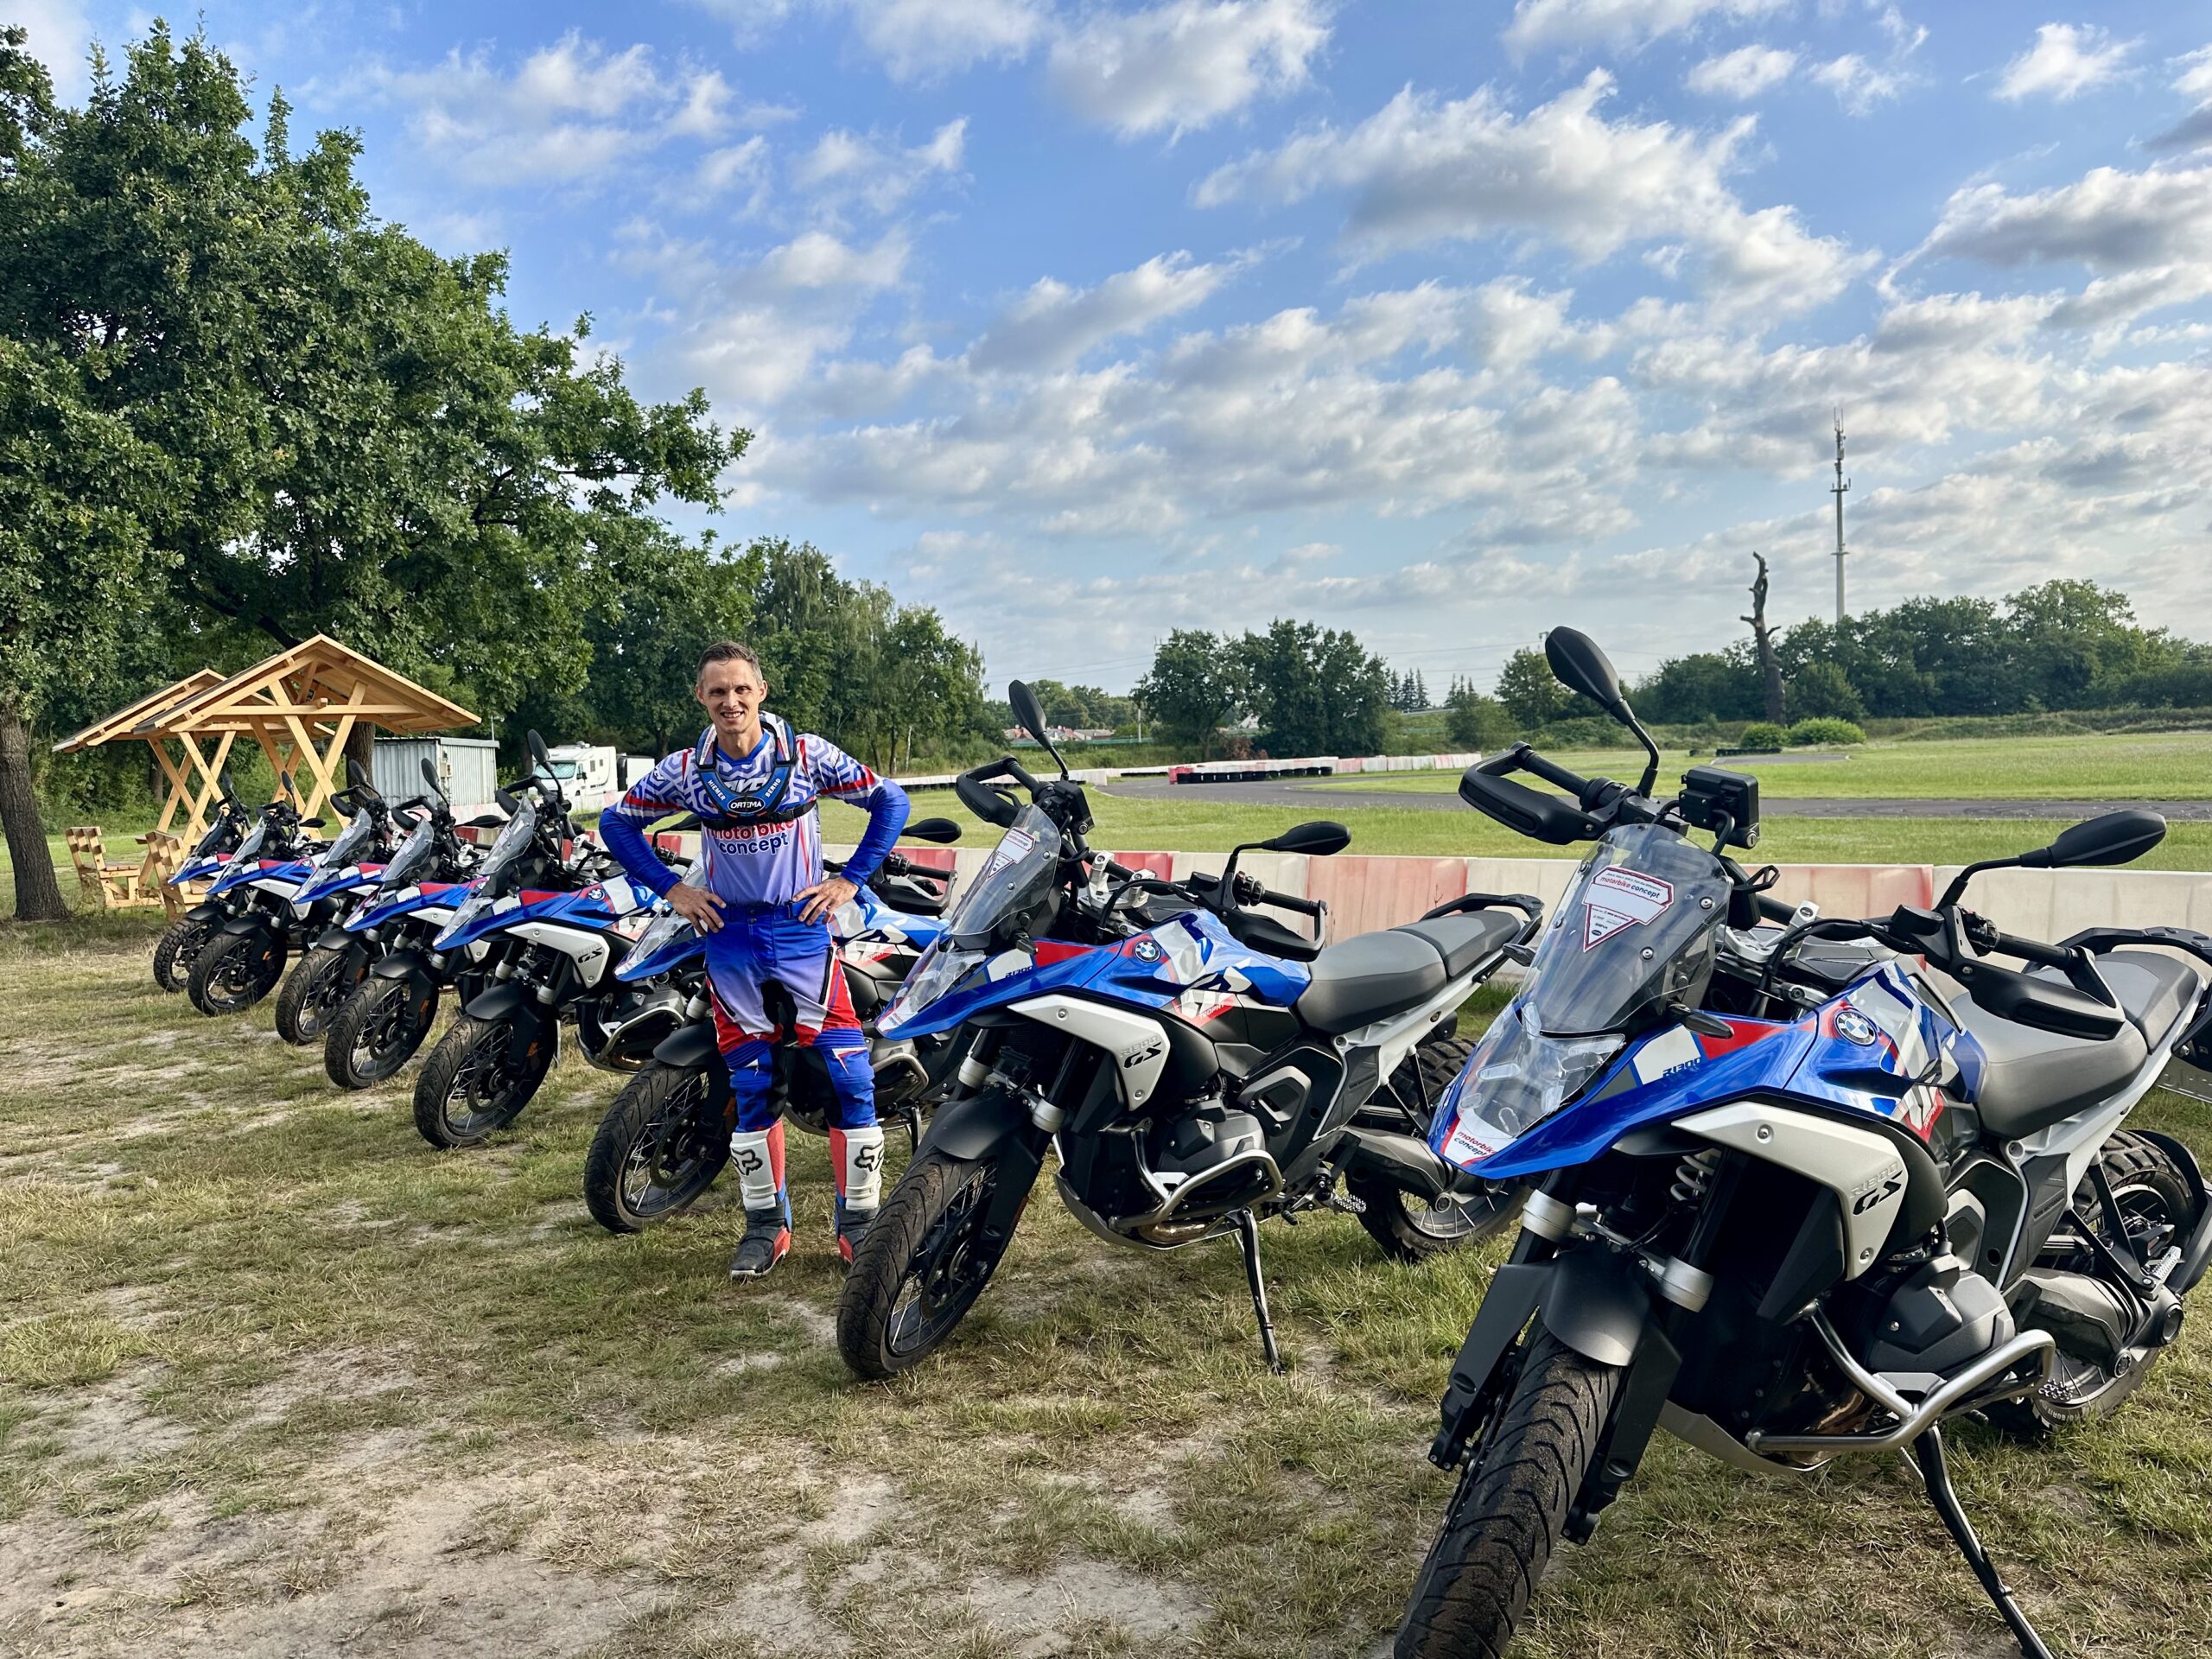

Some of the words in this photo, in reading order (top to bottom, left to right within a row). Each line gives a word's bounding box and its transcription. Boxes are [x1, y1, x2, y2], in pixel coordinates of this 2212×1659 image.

[707, 779, 726, 801] HIEMER
[765, 779, 781, 798] BERND
[719, 832, 789, 855] concept
[1600, 876, 1631, 887] motorbike
[1631, 885, 1660, 898] concept
[578, 946, 602, 963] GS
[1123, 1042, 1161, 1069] GS
[1454, 1137, 1487, 1155] concept
[1853, 1170, 1903, 1215] GS
